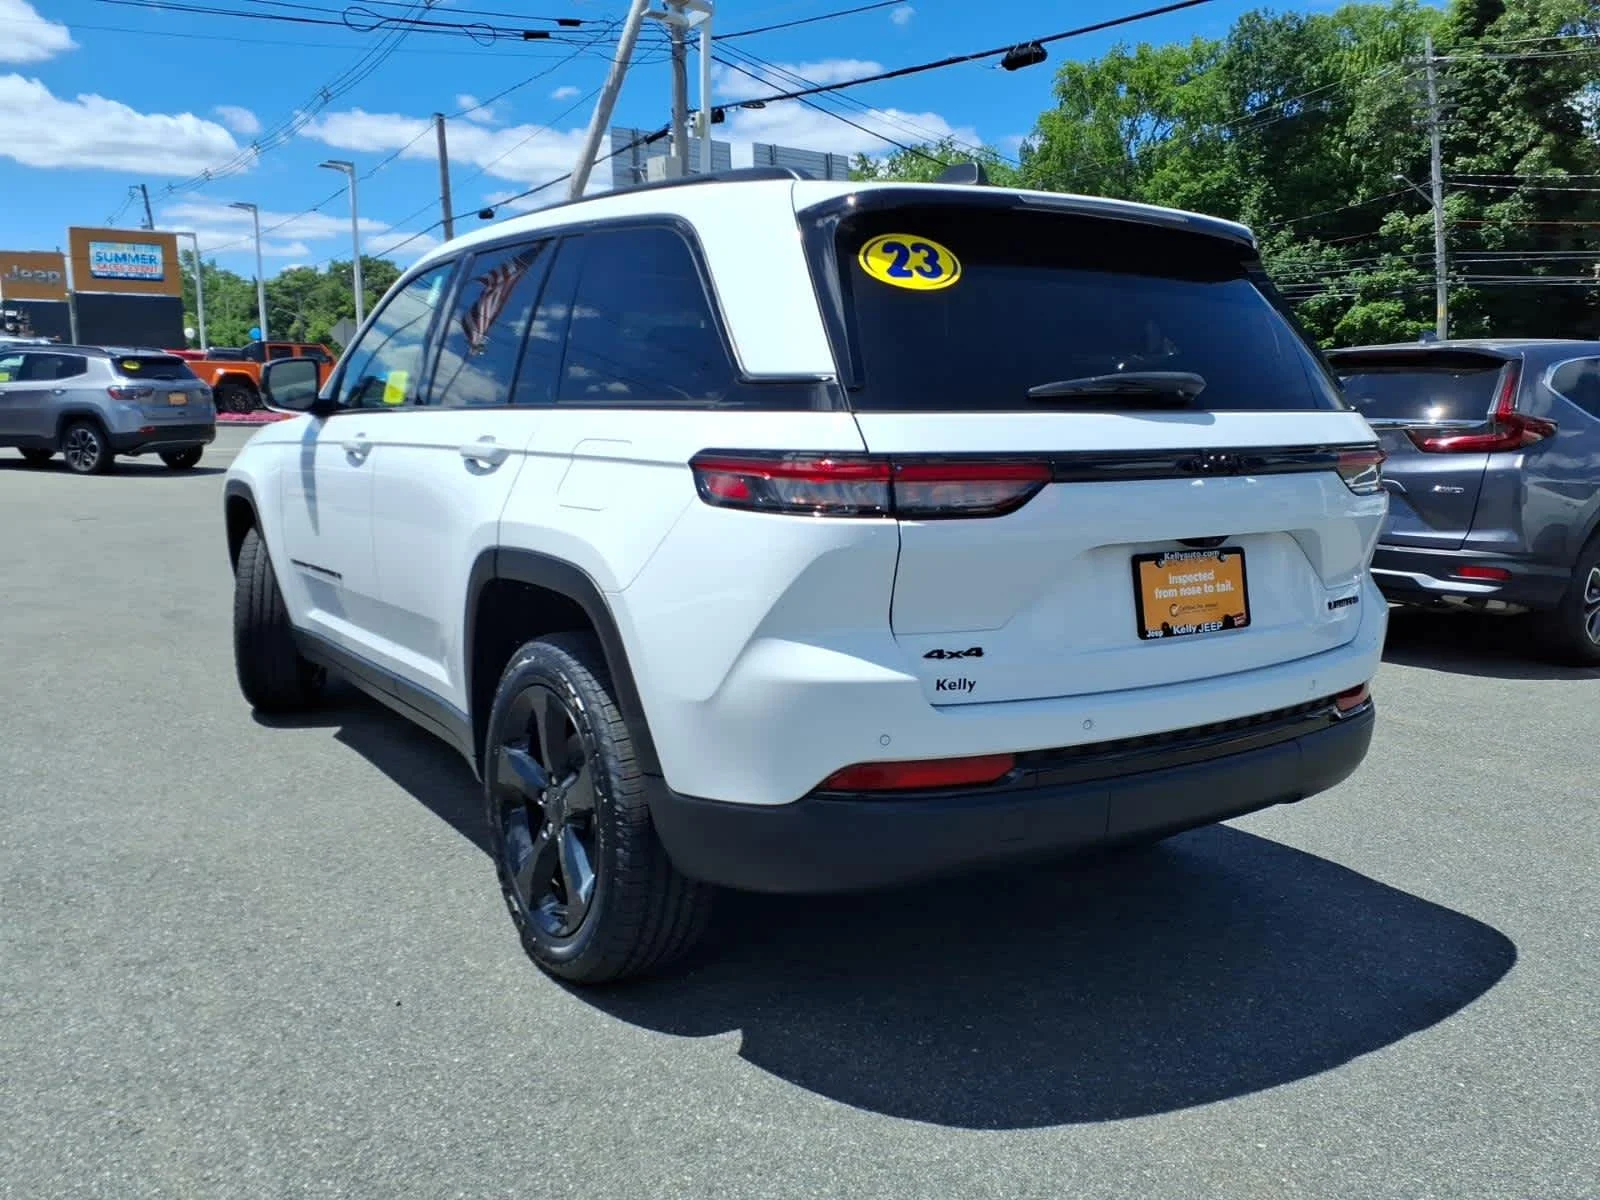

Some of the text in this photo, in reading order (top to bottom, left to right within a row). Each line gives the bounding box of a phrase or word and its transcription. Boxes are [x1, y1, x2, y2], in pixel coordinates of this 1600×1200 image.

[95, 251, 157, 264] SUMMER
[882, 241, 944, 279] 23
[3, 264, 61, 284] Jeep
[1164, 550, 1219, 561] Kellyauto.com
[1168, 569, 1215, 586] Inspected
[1154, 587, 1178, 600] from
[1203, 582, 1215, 593] to
[1146, 629, 1164, 638] Jeep
[1172, 621, 1224, 635] Kelly JEEP
[922, 646, 985, 660] 4x4
[935, 678, 977, 693] Kelly
